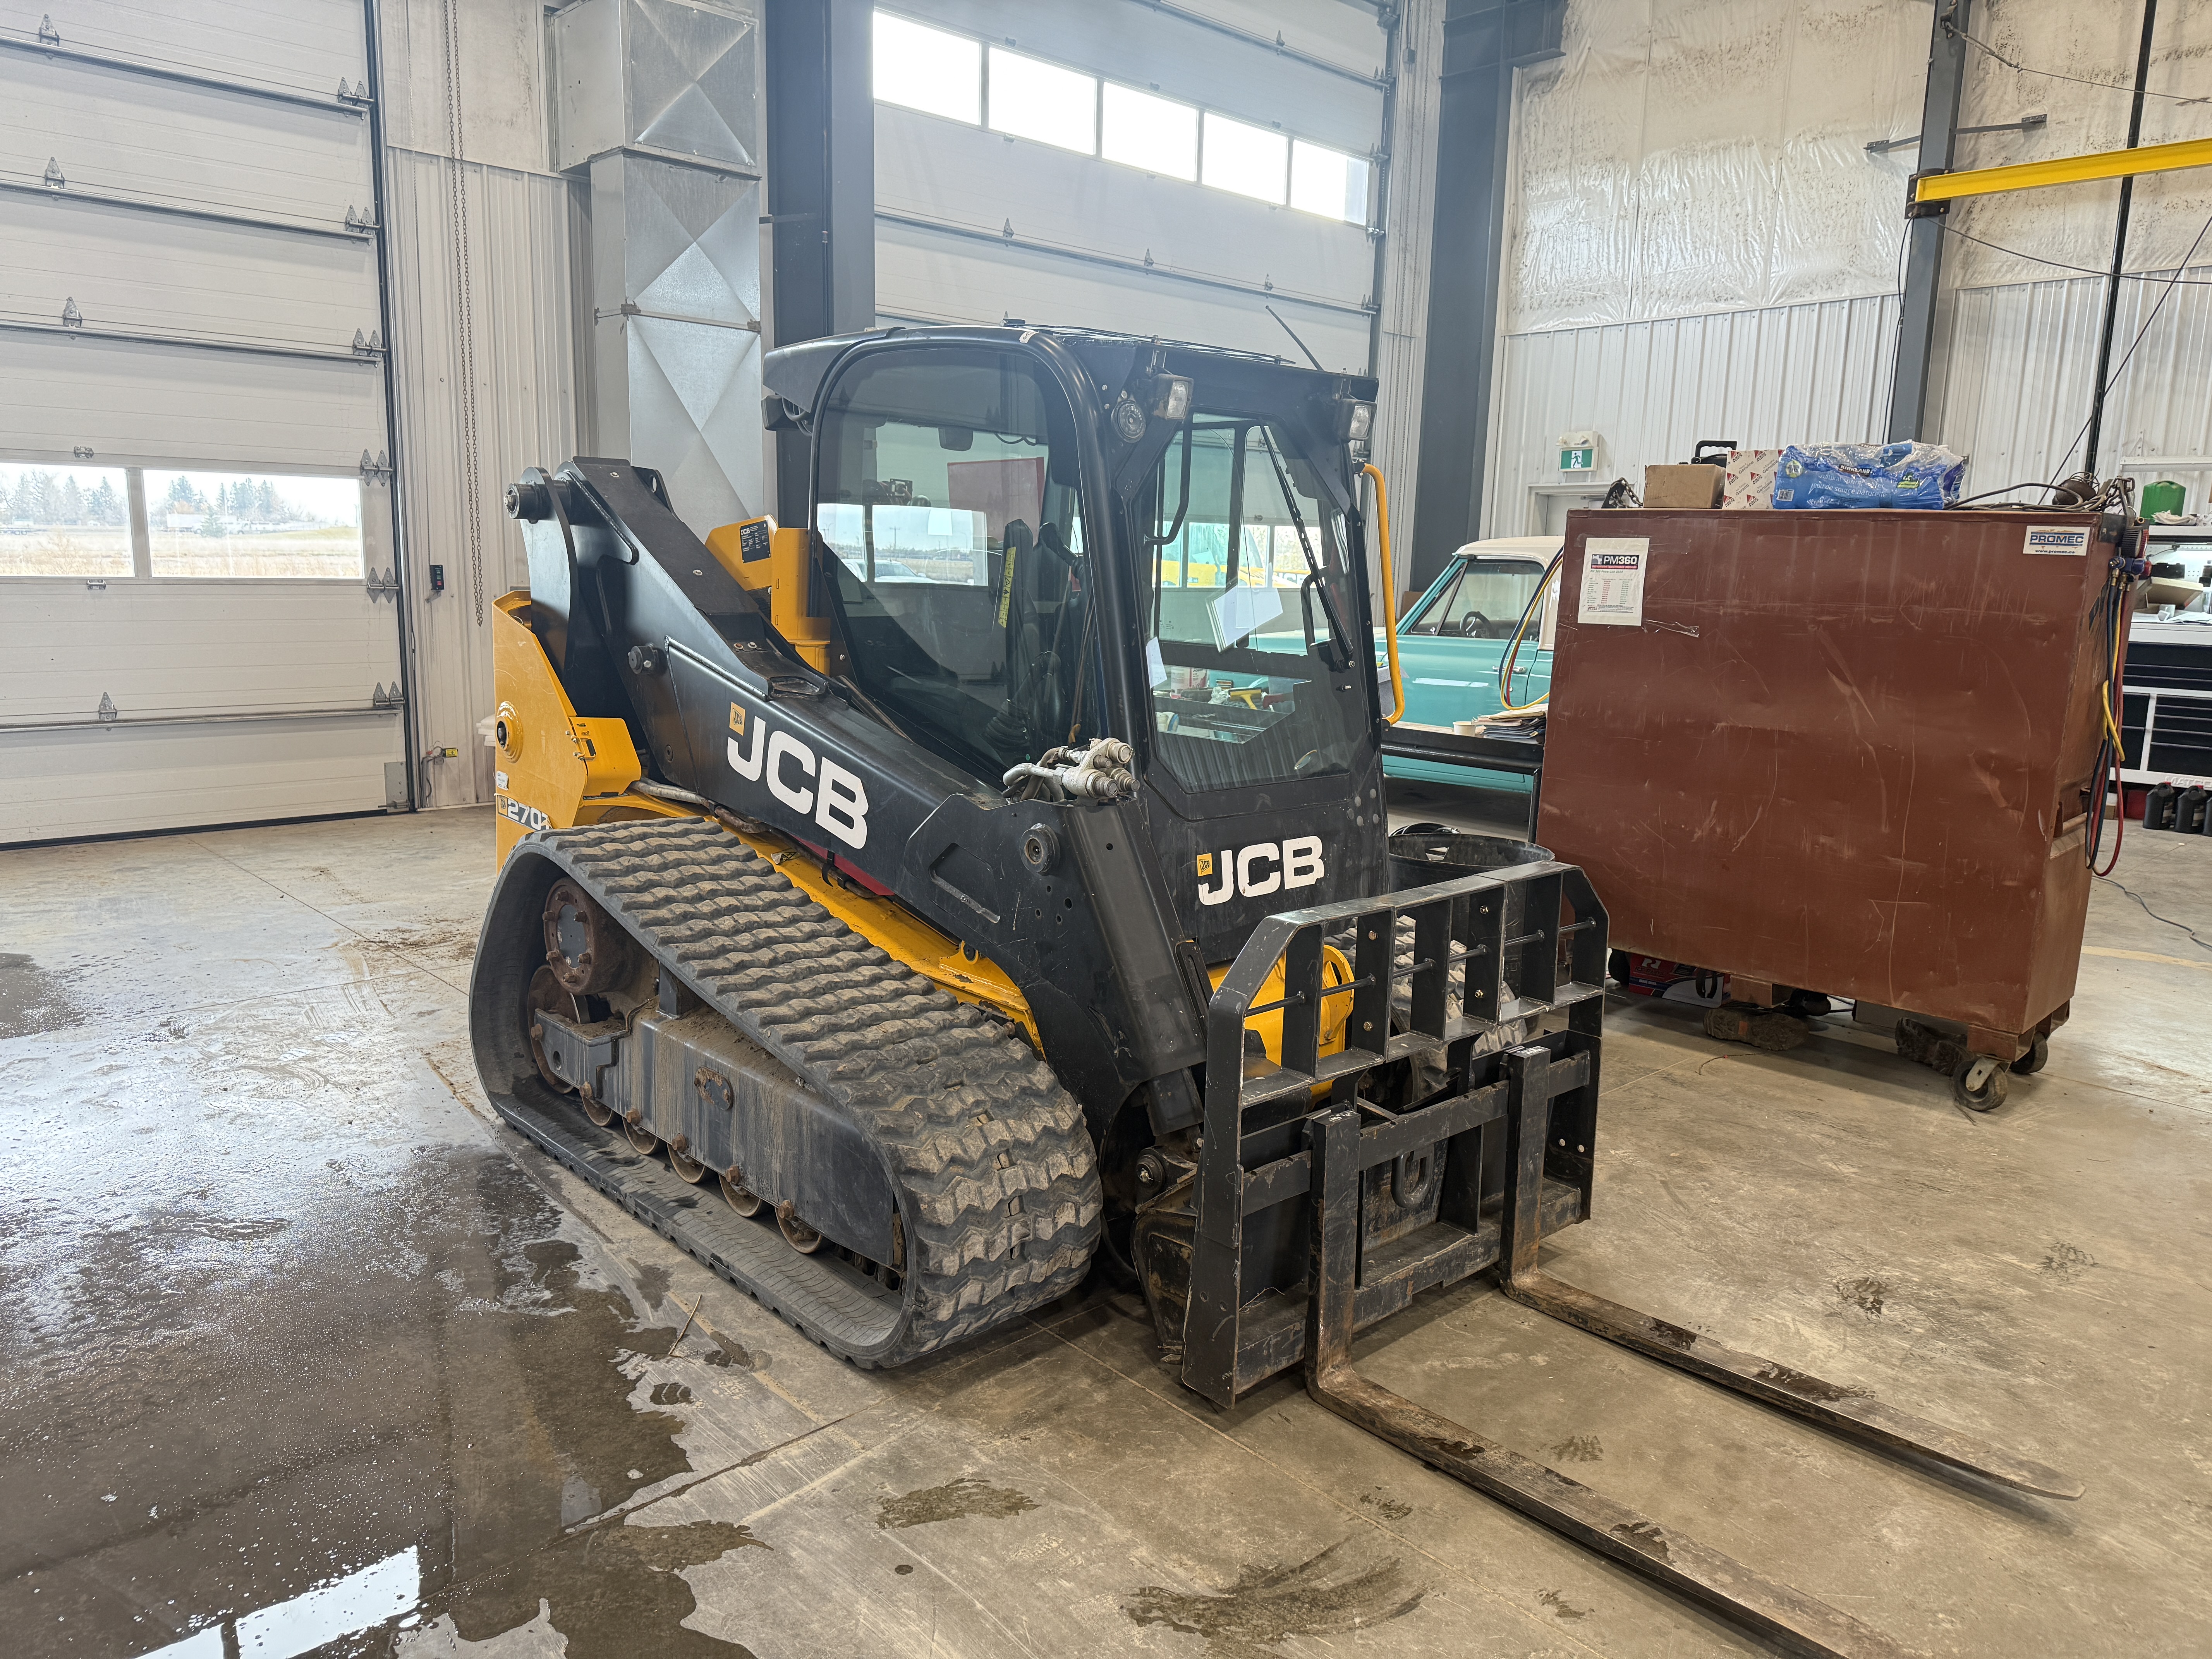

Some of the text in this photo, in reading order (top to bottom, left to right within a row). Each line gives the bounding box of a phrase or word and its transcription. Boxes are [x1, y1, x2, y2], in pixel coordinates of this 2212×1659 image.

[2030, 535, 2084, 543] PROMEC
[1604, 556, 1637, 565] PM360
[727, 716, 869, 849] JCB
[1198, 836, 1324, 905] JCB
